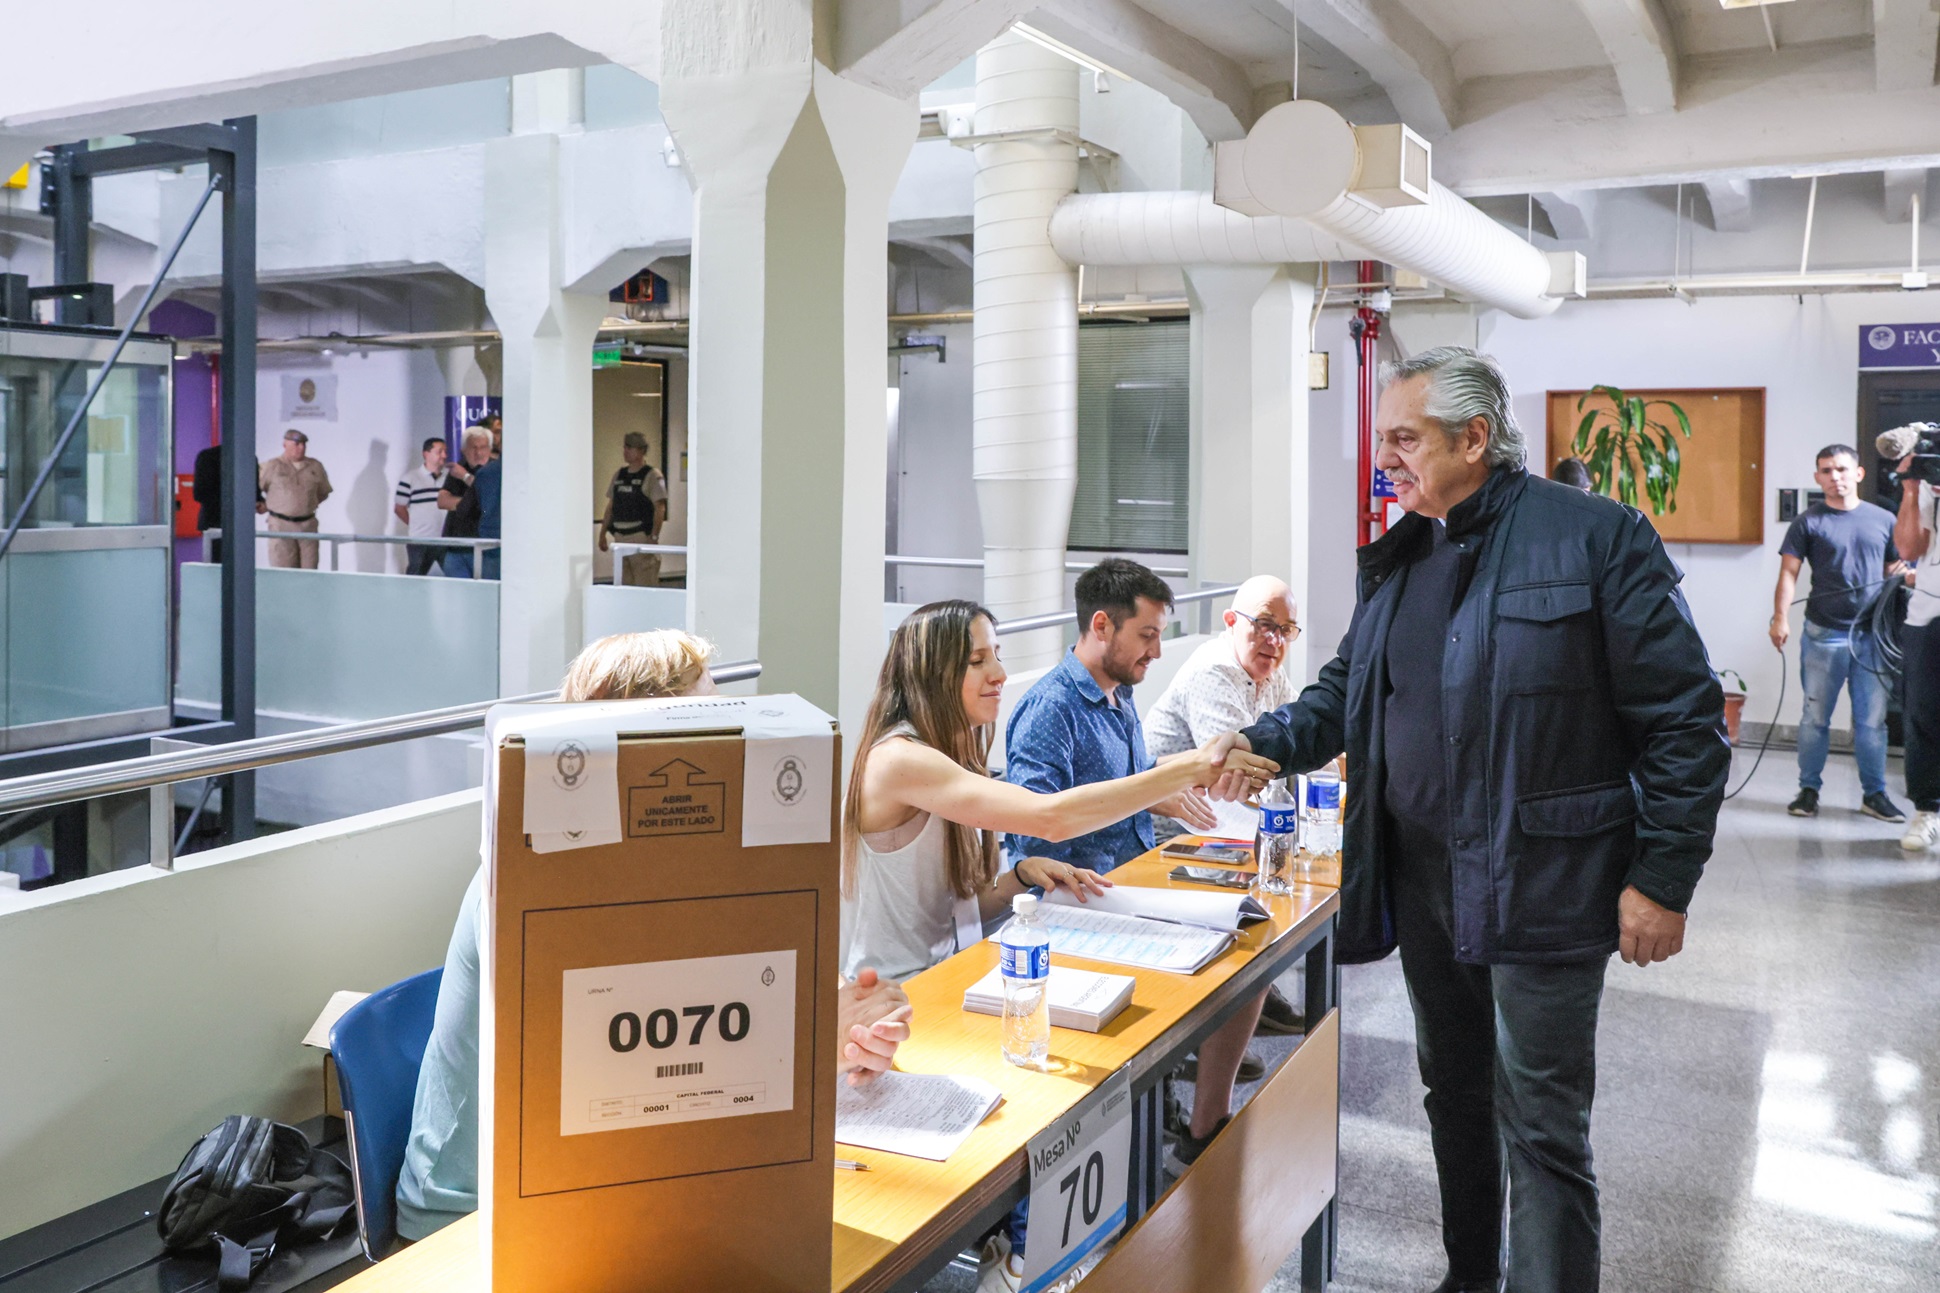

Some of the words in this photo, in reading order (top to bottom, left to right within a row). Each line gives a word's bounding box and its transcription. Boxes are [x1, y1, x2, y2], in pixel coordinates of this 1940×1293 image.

[662, 794, 692, 804] ABRIR
[645, 804, 709, 816] UNICAMENTE
[637, 819, 658, 828] POR
[661, 817, 686, 827] ESTE
[688, 815, 715, 825] LADO
[608, 1001, 750, 1053] 0070
[676, 1091, 699, 1099] CAPITAL
[700, 1088, 724, 1096] FEDERAL
[643, 1104, 670, 1114] 00001
[733, 1095, 755, 1105] 0004
[1033, 1138, 1065, 1178] Mesa
[1060, 1150, 1104, 1249] 70
